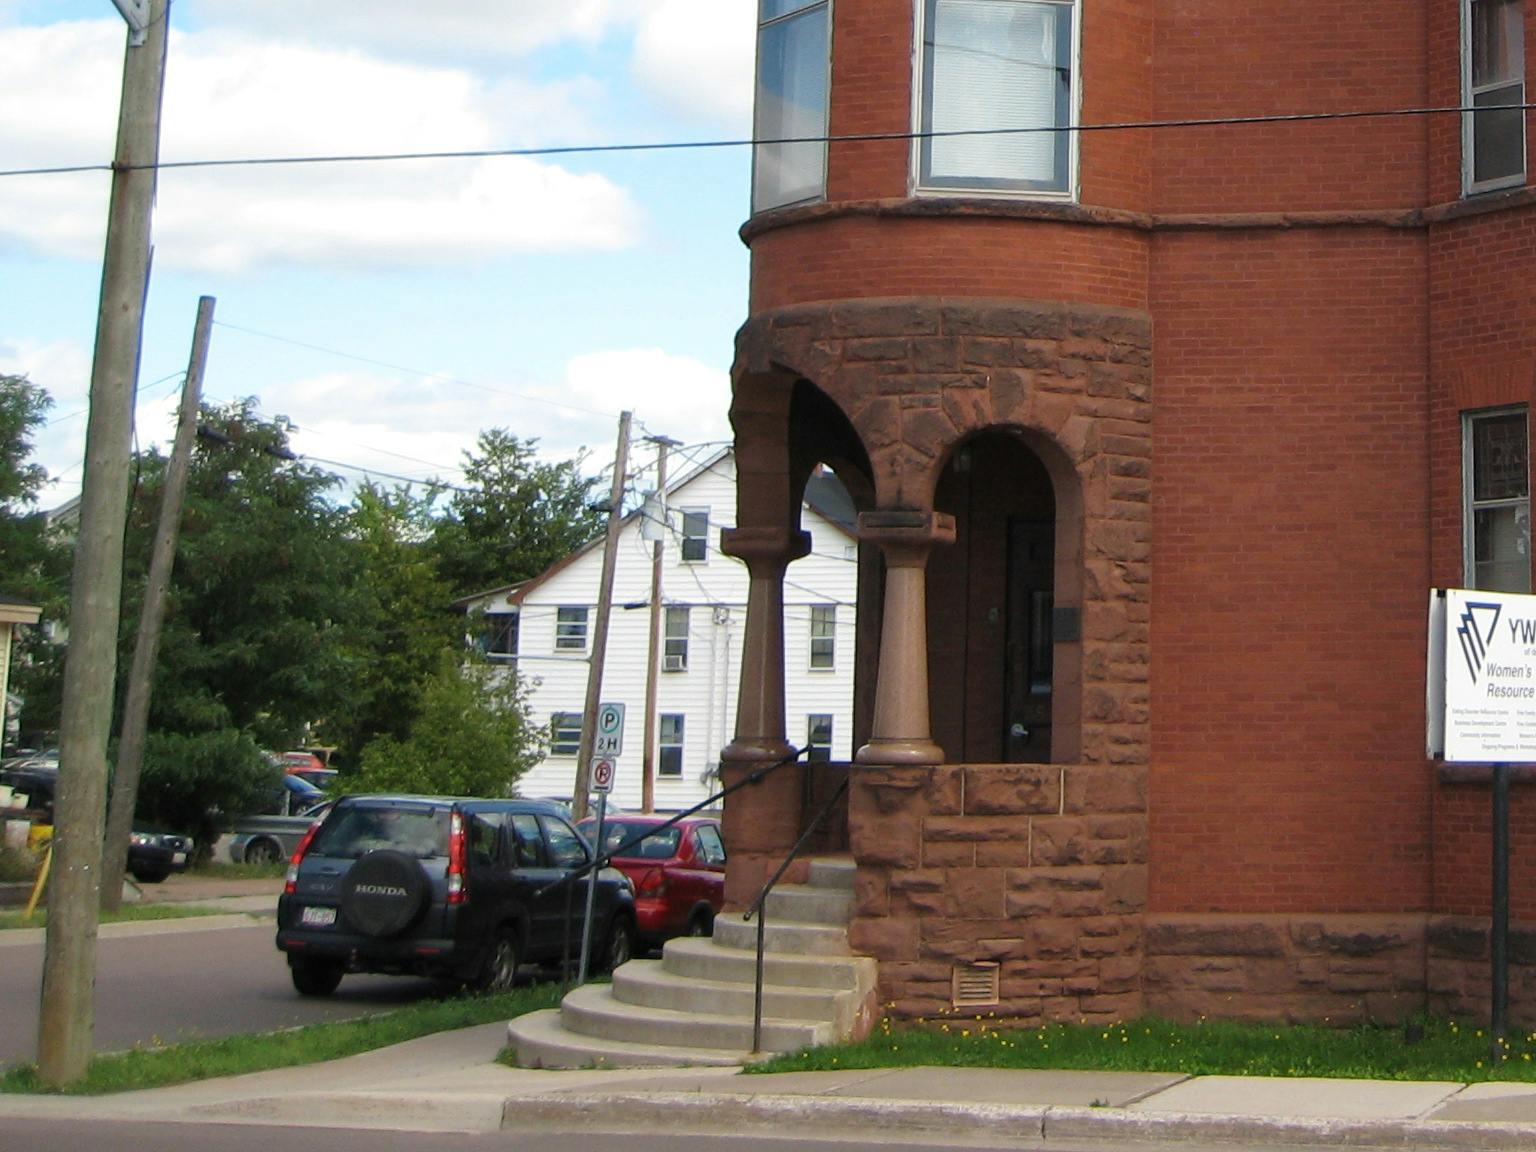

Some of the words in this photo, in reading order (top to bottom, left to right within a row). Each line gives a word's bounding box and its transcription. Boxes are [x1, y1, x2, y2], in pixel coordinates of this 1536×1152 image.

[1486, 662, 1532, 678] Women's
[1486, 683, 1535, 698] Resource
[605, 713, 615, 728] P
[355, 884, 408, 896] HONDA
